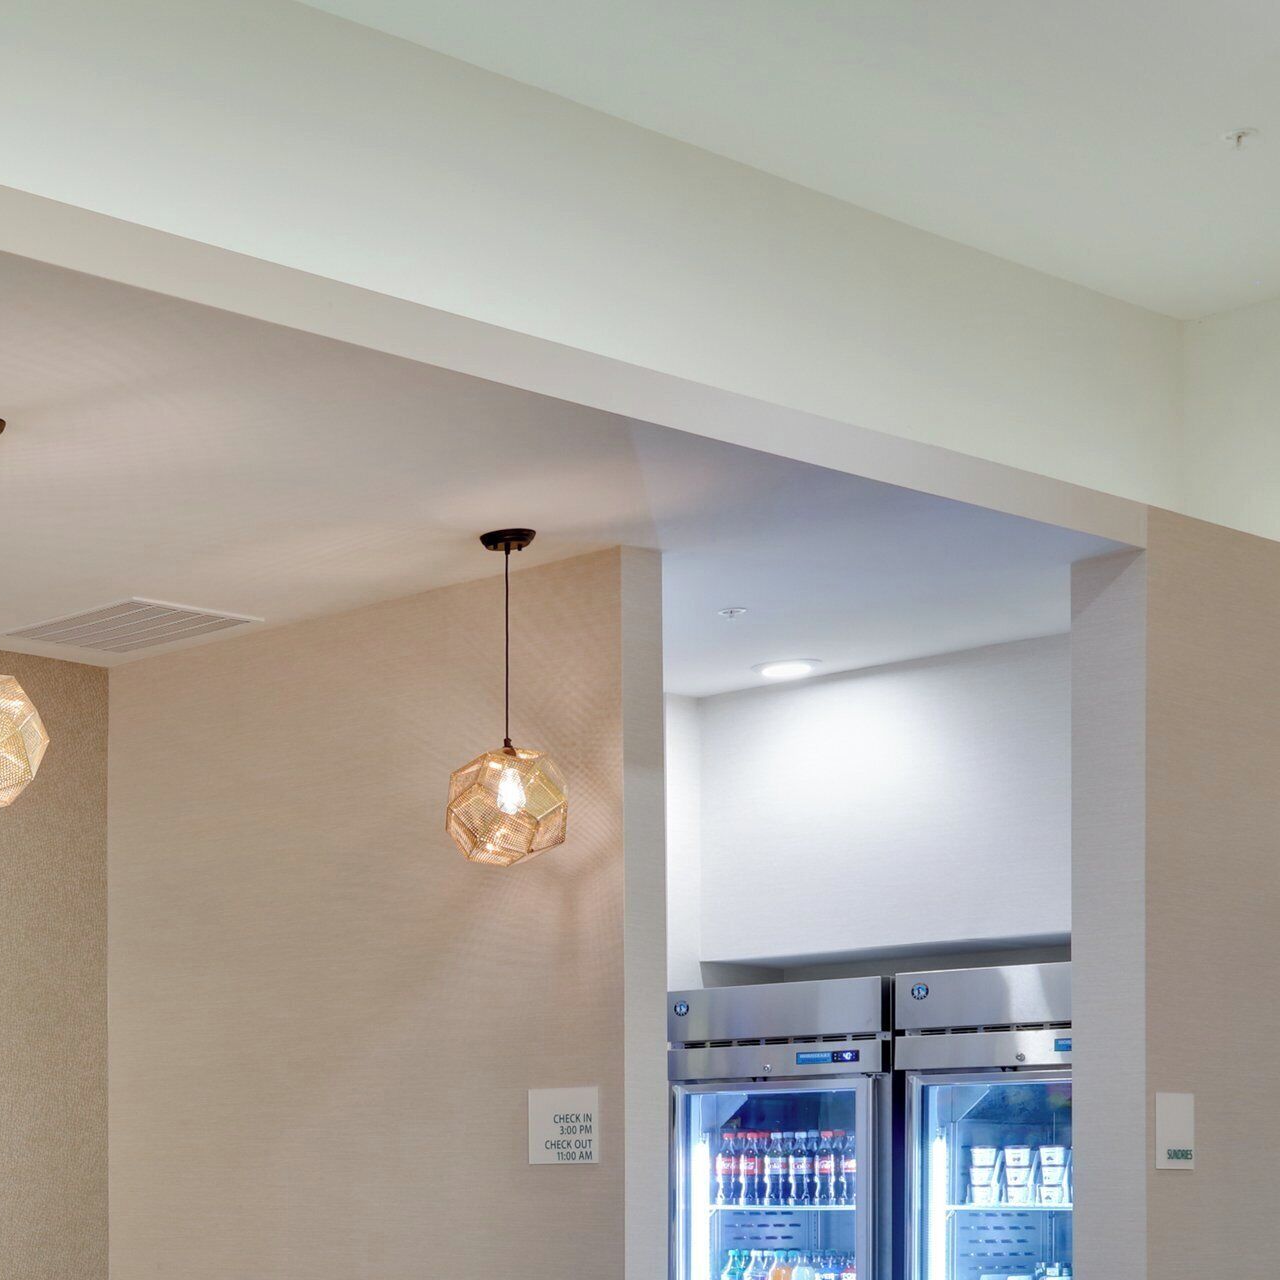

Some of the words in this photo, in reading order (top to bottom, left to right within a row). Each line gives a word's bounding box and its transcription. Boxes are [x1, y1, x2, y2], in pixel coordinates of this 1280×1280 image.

[553, 1113, 581, 1124] CHECK
[583, 1113, 592, 1123] IN
[559, 1125, 577, 1135] 3:00
[579, 1124, 592, 1135] PM
[544, 1140, 572, 1149] CHECK
[574, 1139, 593, 1149] OUT
[557, 1151, 577, 1161] 11:00
[578, 1150, 593, 1160] AM
[1167, 1148, 1193, 1160] SUNDRIES
